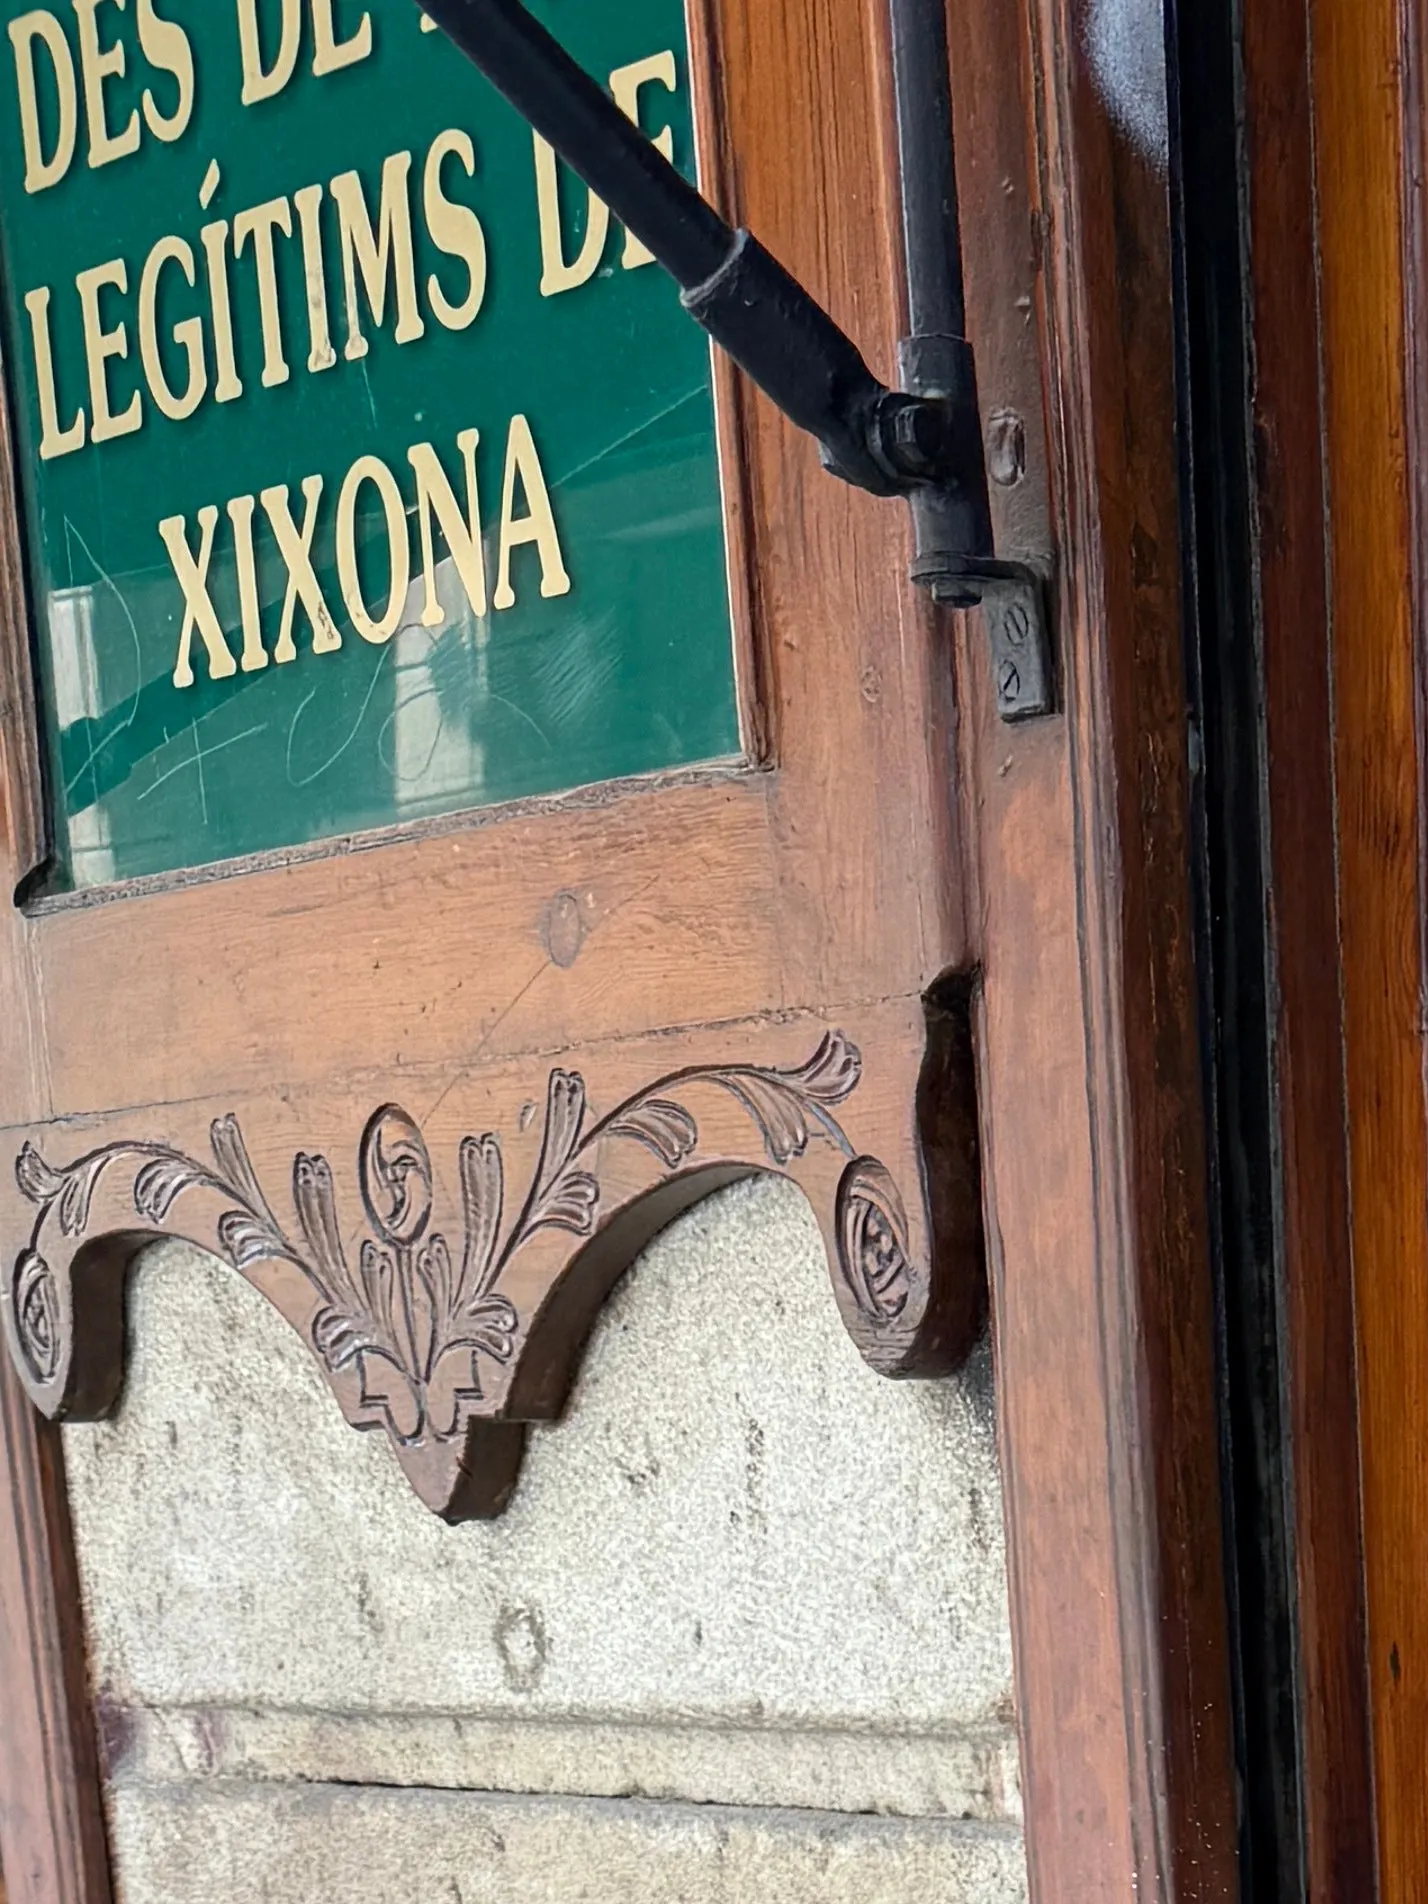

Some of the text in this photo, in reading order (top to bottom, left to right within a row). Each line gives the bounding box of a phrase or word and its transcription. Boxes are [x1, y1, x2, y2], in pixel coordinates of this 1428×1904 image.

[8, 0, 195, 194] DES
[26, 129, 487, 461] LEGÍTIMS
[158, 413, 571, 689] XIXONA
